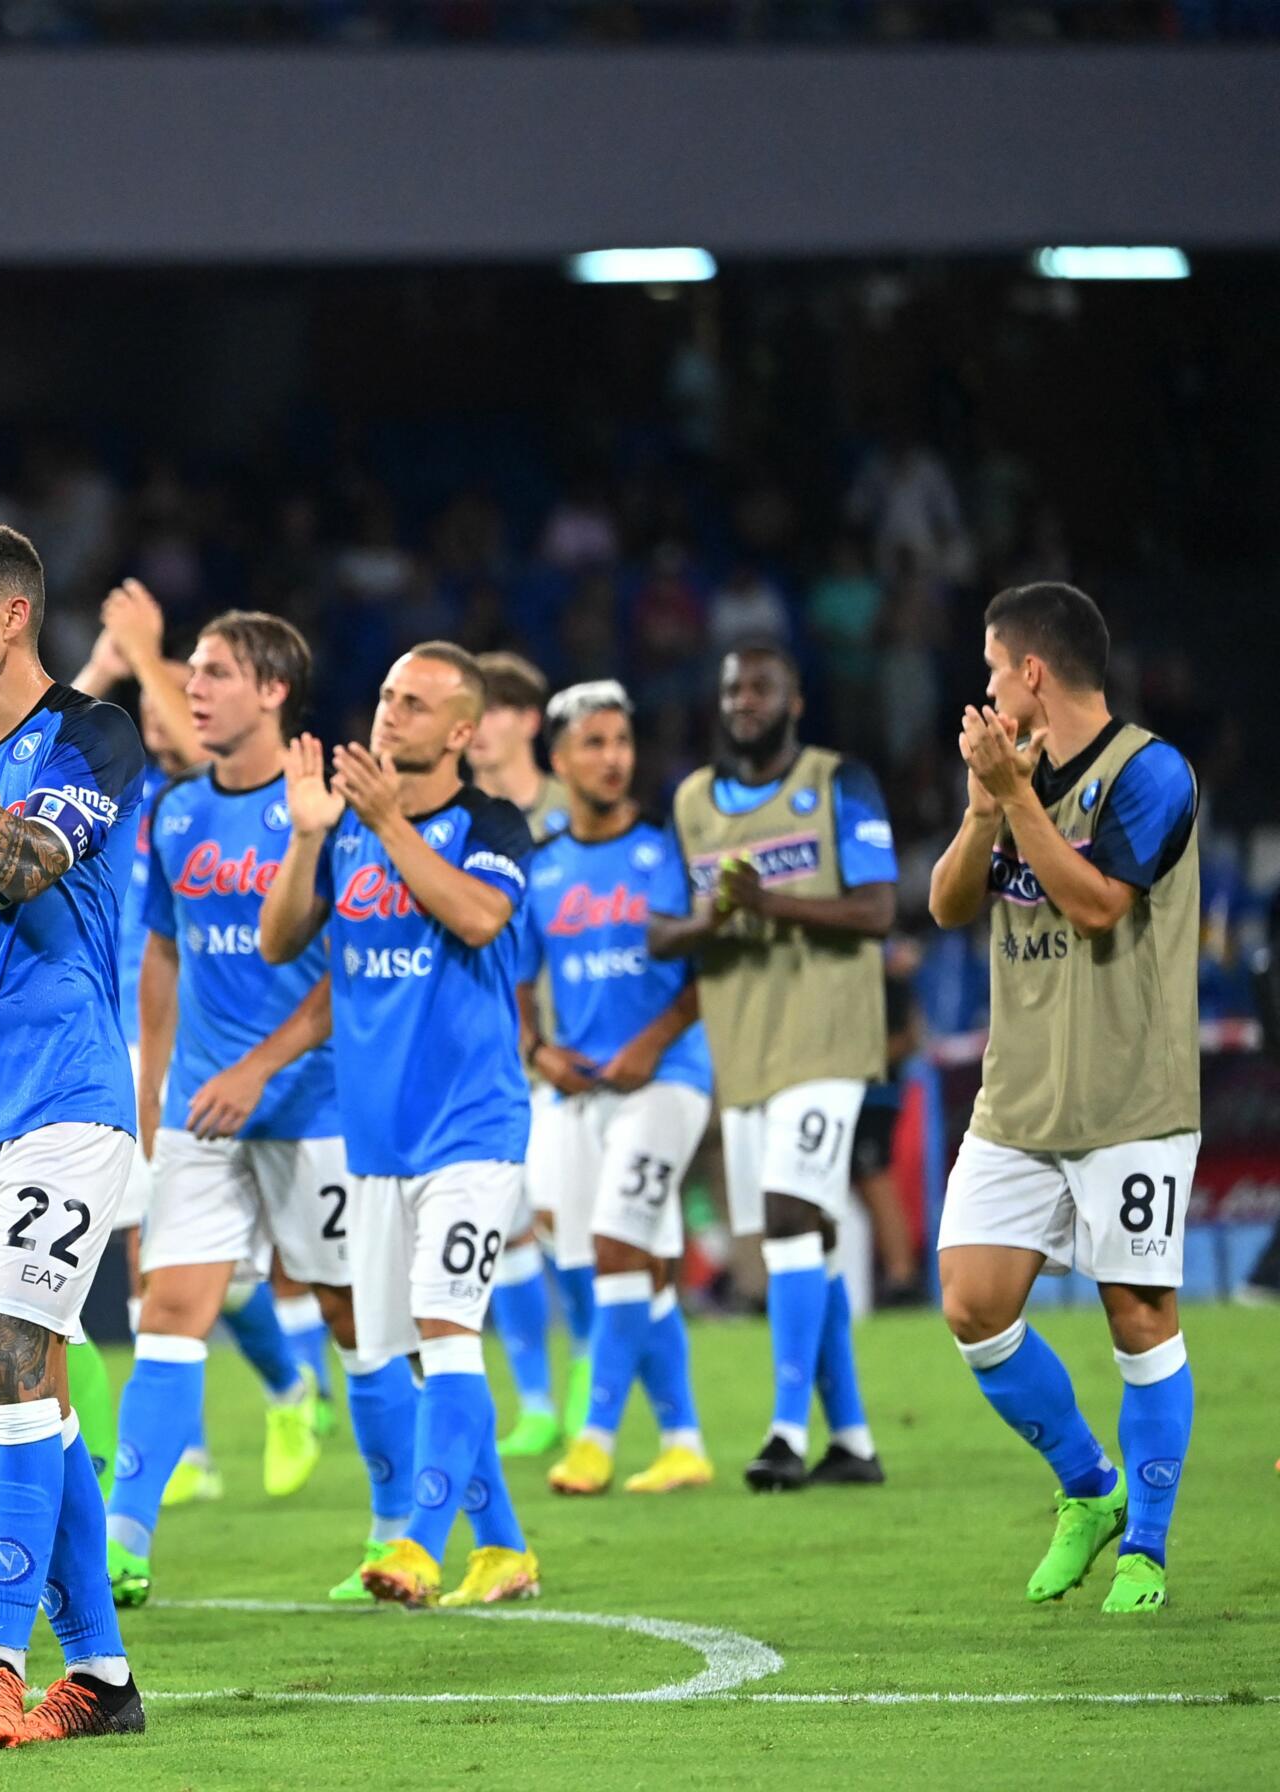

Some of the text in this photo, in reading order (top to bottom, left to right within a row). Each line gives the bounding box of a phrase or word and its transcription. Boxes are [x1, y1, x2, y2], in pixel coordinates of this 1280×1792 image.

[63, 784, 119, 822] amaz
[207, 924, 261, 955] MS
[364, 946, 433, 978] MSC
[797, 1109, 844, 1172] 91
[1120, 1173, 1176, 1238] 81
[4, 1186, 91, 1269] 22
[442, 1221, 501, 1284] 68
[1131, 1238, 1167, 1256] EA7
[21, 1264, 68, 1293] EA7
